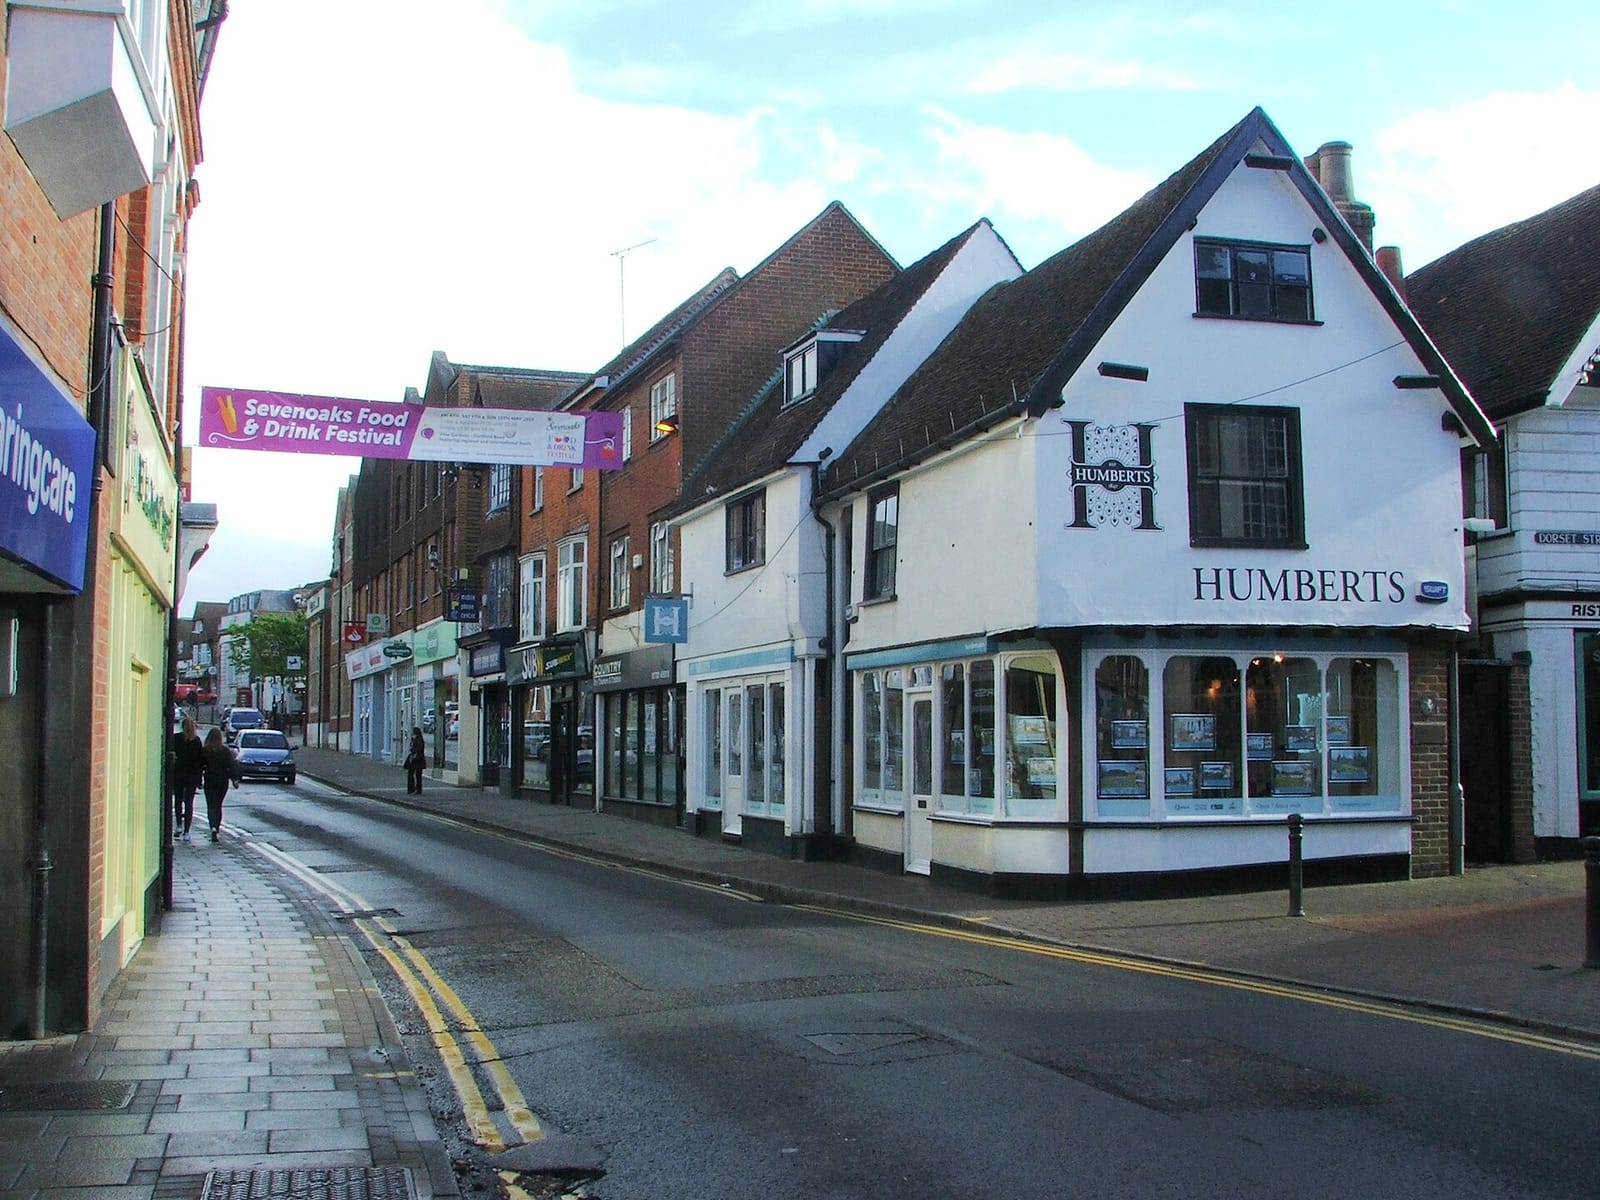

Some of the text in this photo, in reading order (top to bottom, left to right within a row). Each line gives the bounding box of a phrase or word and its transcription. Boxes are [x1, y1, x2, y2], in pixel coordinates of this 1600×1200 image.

[244, 399, 409, 428] Sevenoaks Food
[243, 418, 402, 446] & Drink Festival
[1075, 468, 1151, 483] HUMBERTS
[1539, 533, 1576, 544] DORSET
[1191, 567, 1406, 604] HUMBERTS
[594, 660, 622, 676] COUNTRY
